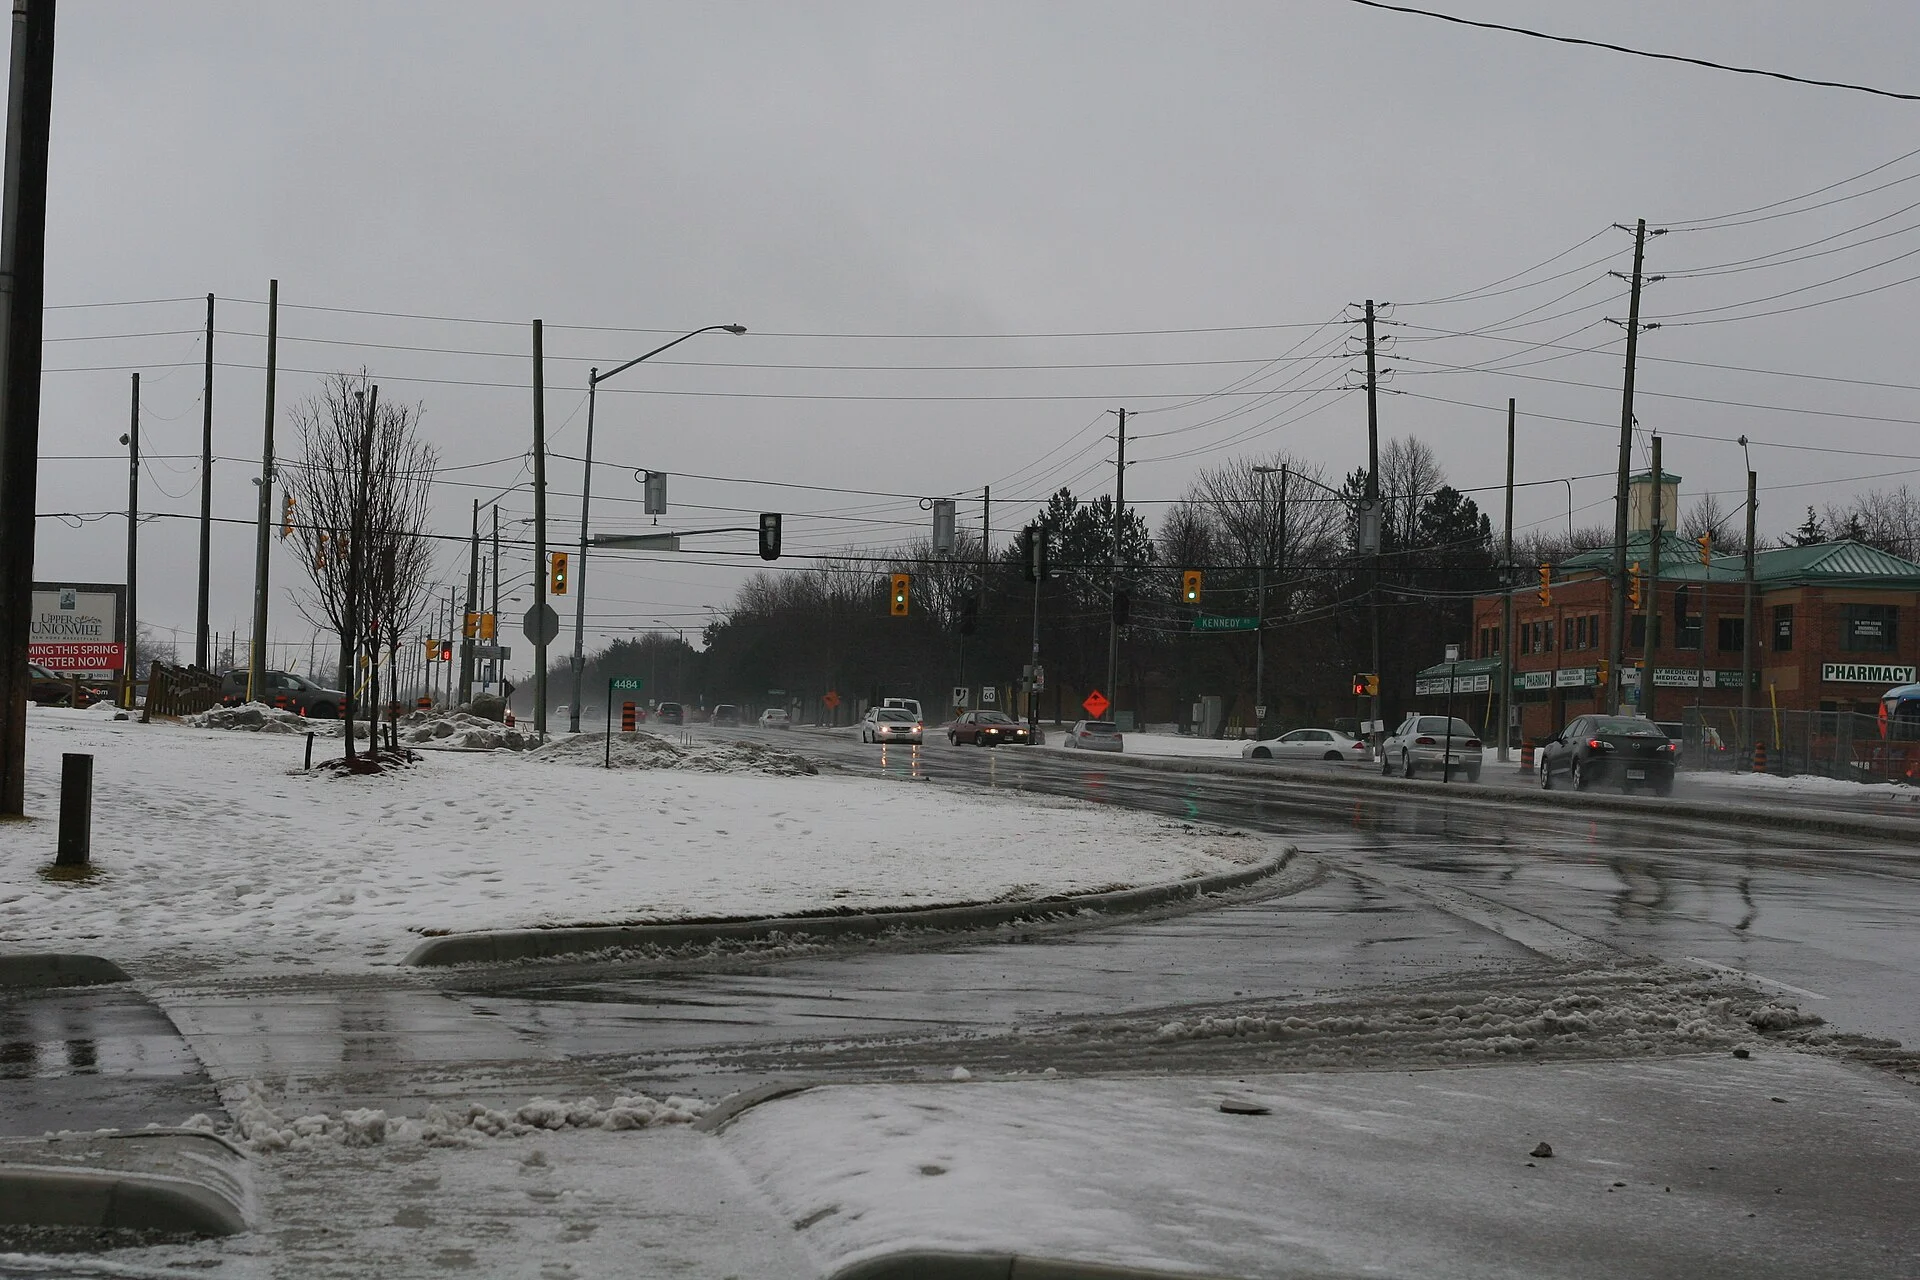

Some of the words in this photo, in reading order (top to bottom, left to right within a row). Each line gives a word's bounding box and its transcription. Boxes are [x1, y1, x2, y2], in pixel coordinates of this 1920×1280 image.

[1202, 618, 1241, 628] KENNEDY
[28, 646, 54, 655] MING
[56, 645, 79, 655] THIS
[81, 645, 119, 654] SPRING
[29, 657, 75, 667] EGISTER
[78, 656, 107, 667] NOW
[1824, 664, 1913, 682] PHARMACY
[614, 680, 638, 689] 4484
[984, 692, 994, 700] 60
